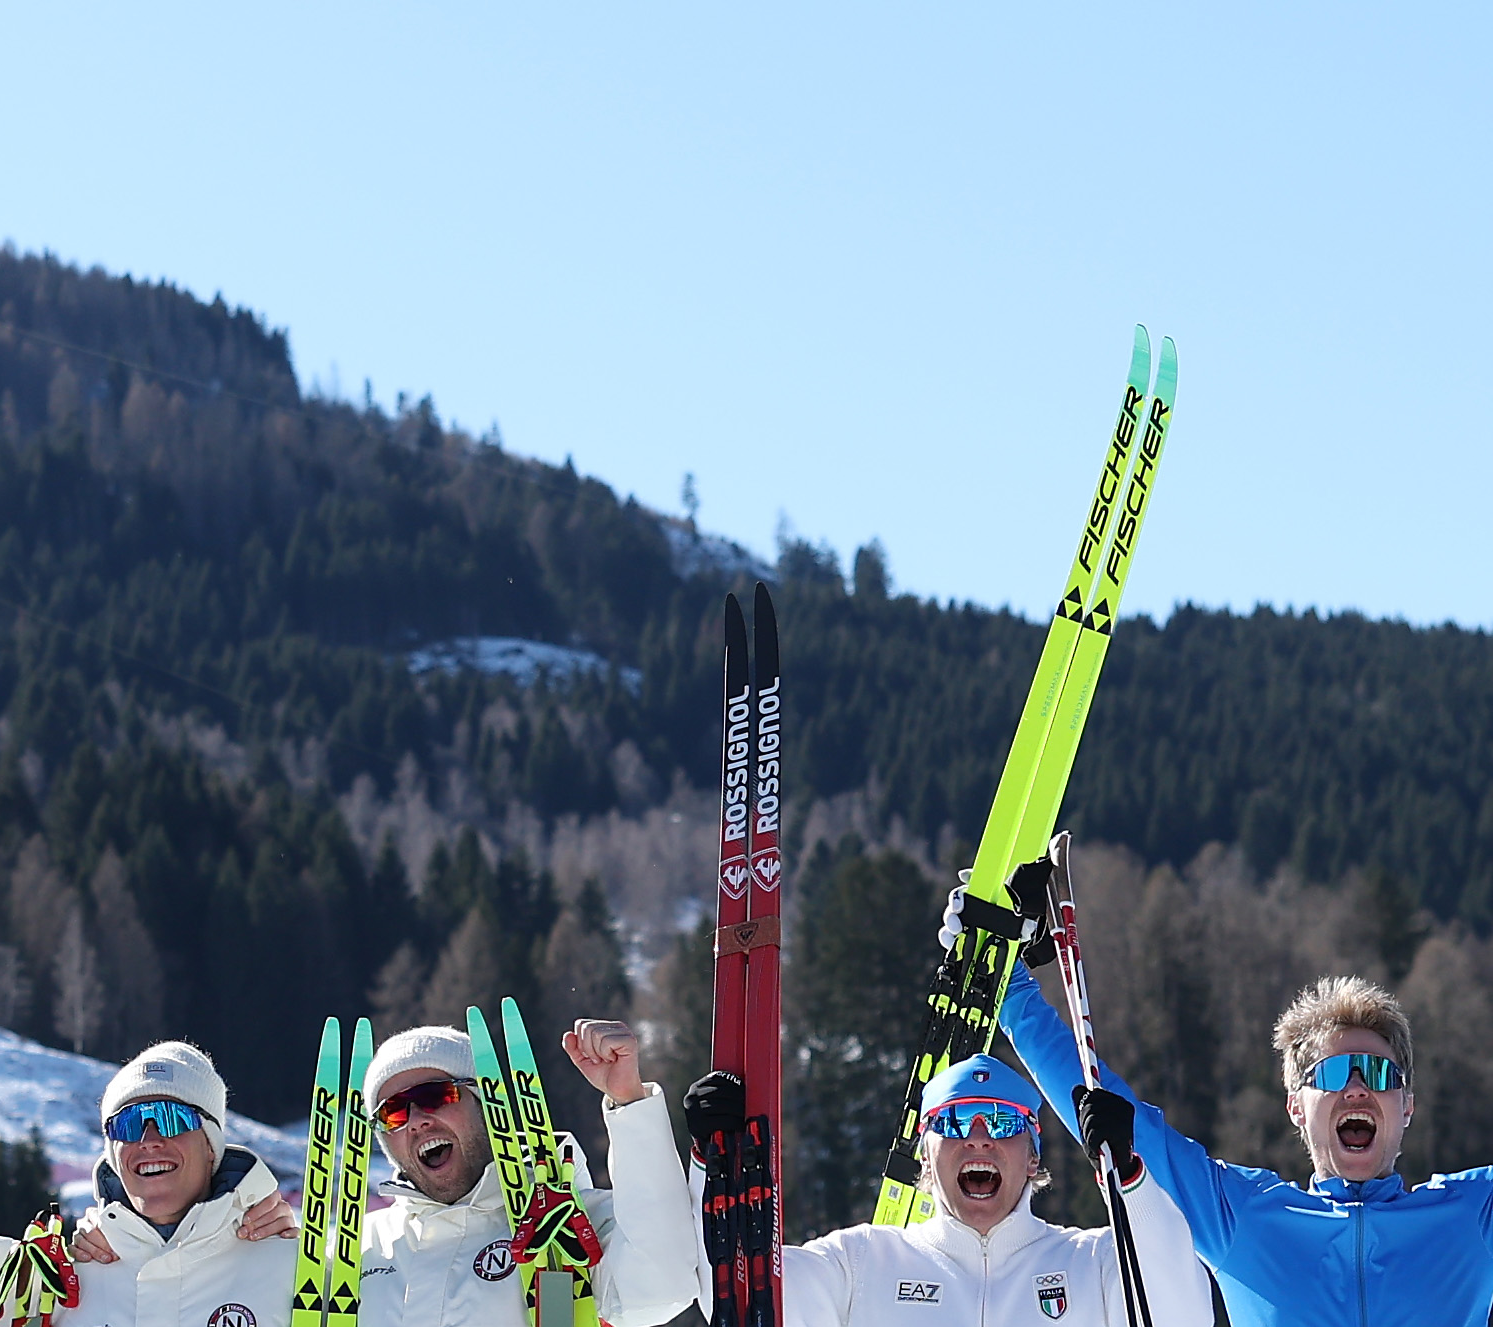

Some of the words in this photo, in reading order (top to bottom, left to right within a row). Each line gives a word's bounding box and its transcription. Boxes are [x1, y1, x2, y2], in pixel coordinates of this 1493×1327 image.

[1078, 385, 1143, 573] FISCHER
[1106, 396, 1169, 586] FISCHER
[725, 685, 751, 842] ROSSIGNOL
[756, 677, 780, 835] ROSSIGNOL
[304, 1087, 336, 1265] FISCHER
[339, 1088, 371, 1268] FISCHER
[479, 1075, 528, 1243] ISCHER
[49, 1235, 60, 1255] EKI
[898, 1282, 940, 1298] EA7
[1039, 1288, 1063, 1297] ITALIA
